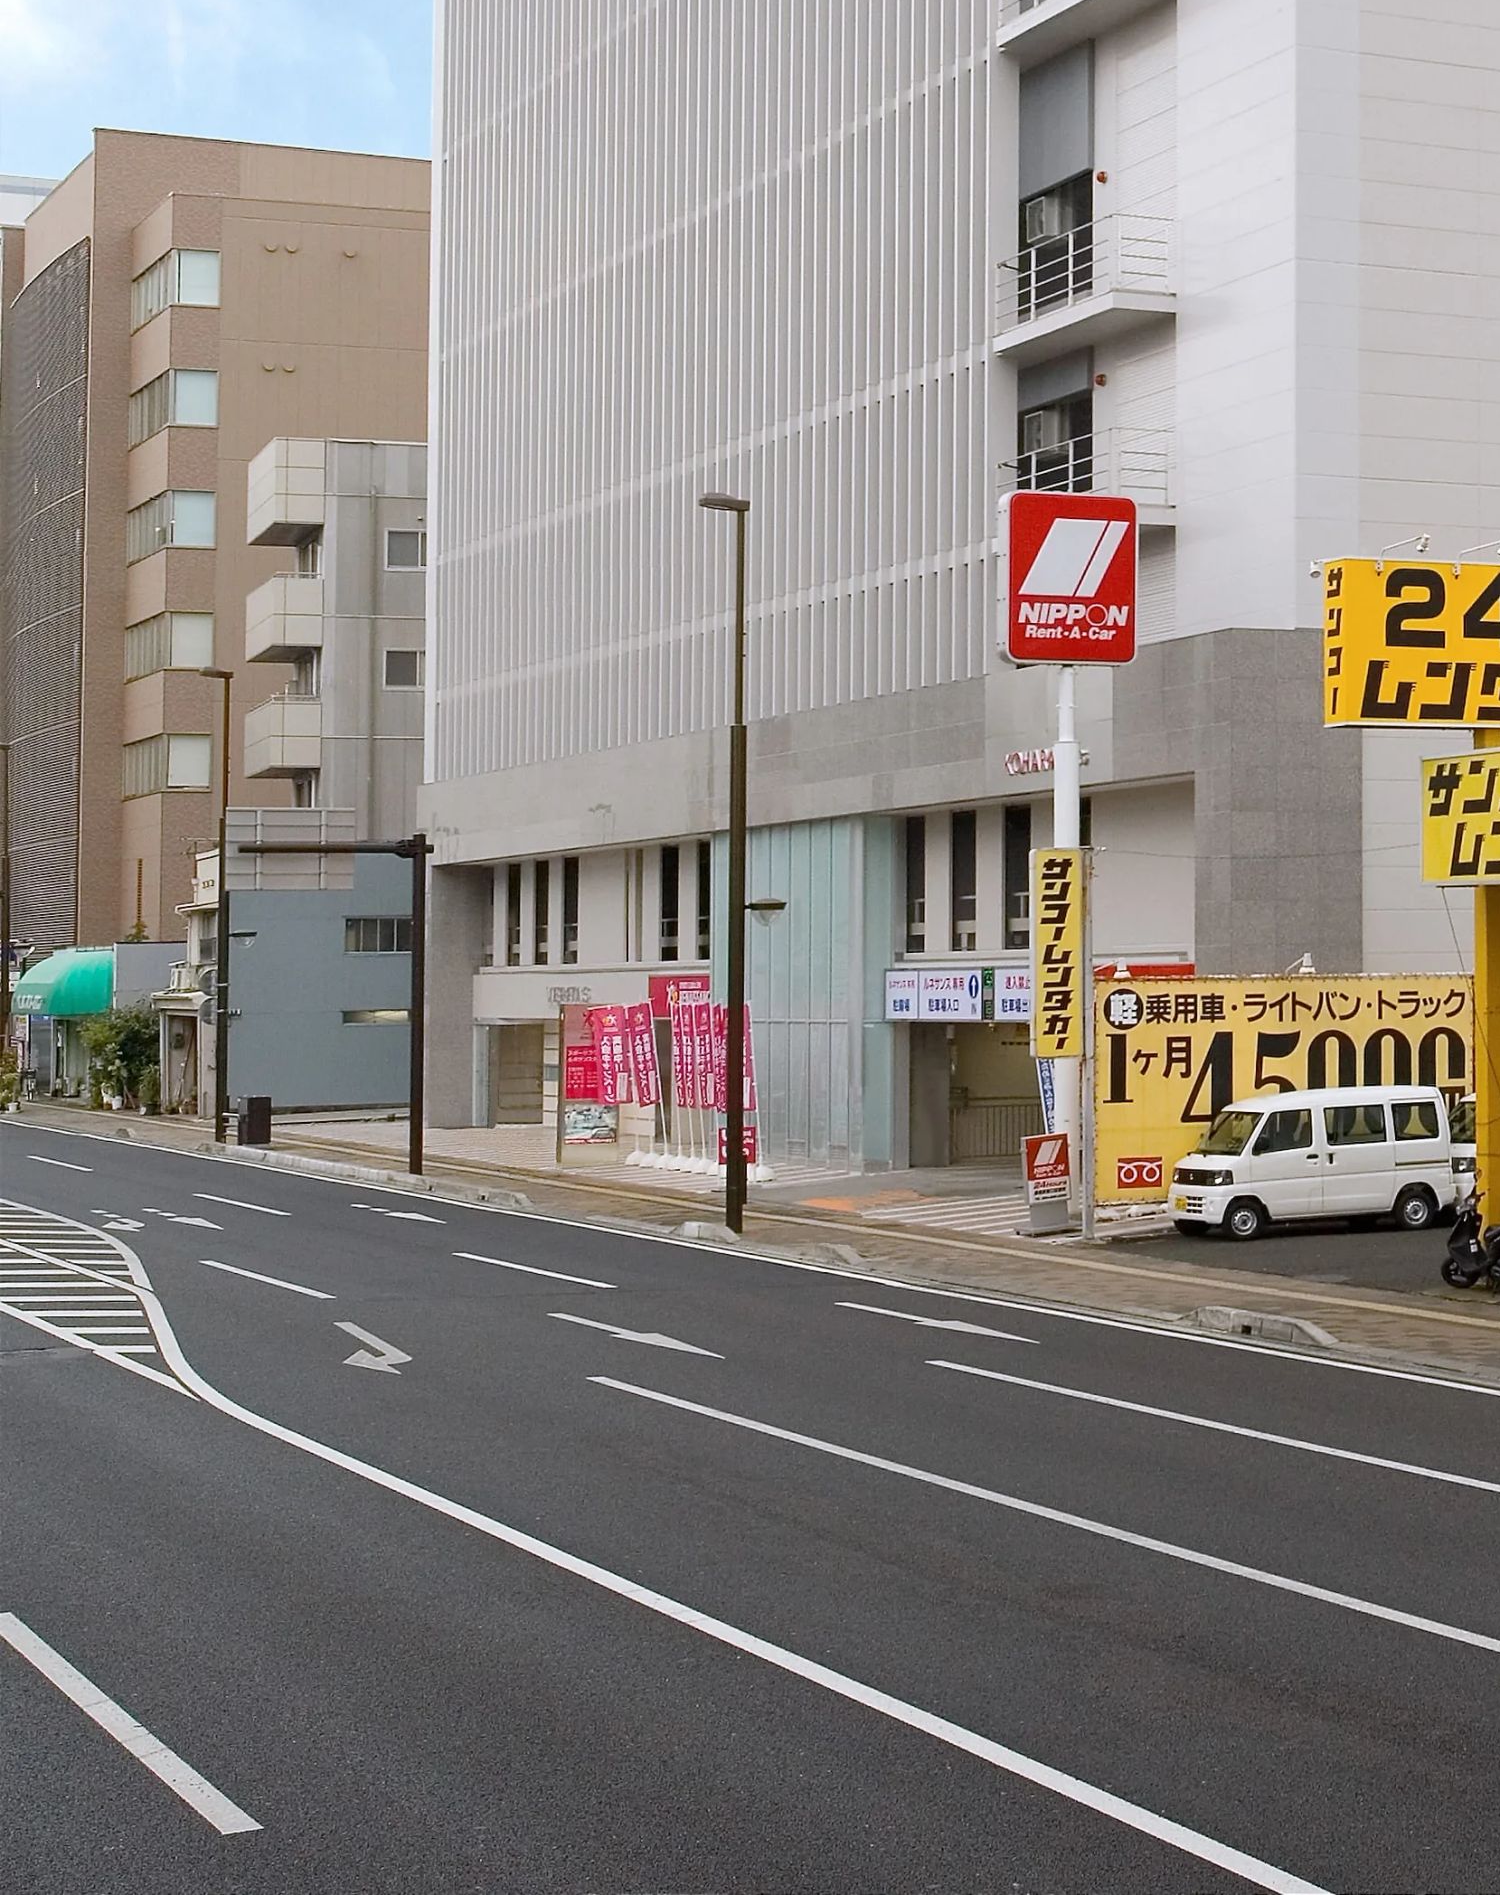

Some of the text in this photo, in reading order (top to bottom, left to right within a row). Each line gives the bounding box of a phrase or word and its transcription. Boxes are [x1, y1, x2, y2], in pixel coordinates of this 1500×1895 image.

[1018, 602, 1129, 626] NIPPON
[1327, 567, 1343, 715] サンコー
[1040, 858, 1075, 1051] サンコーレンタカー
